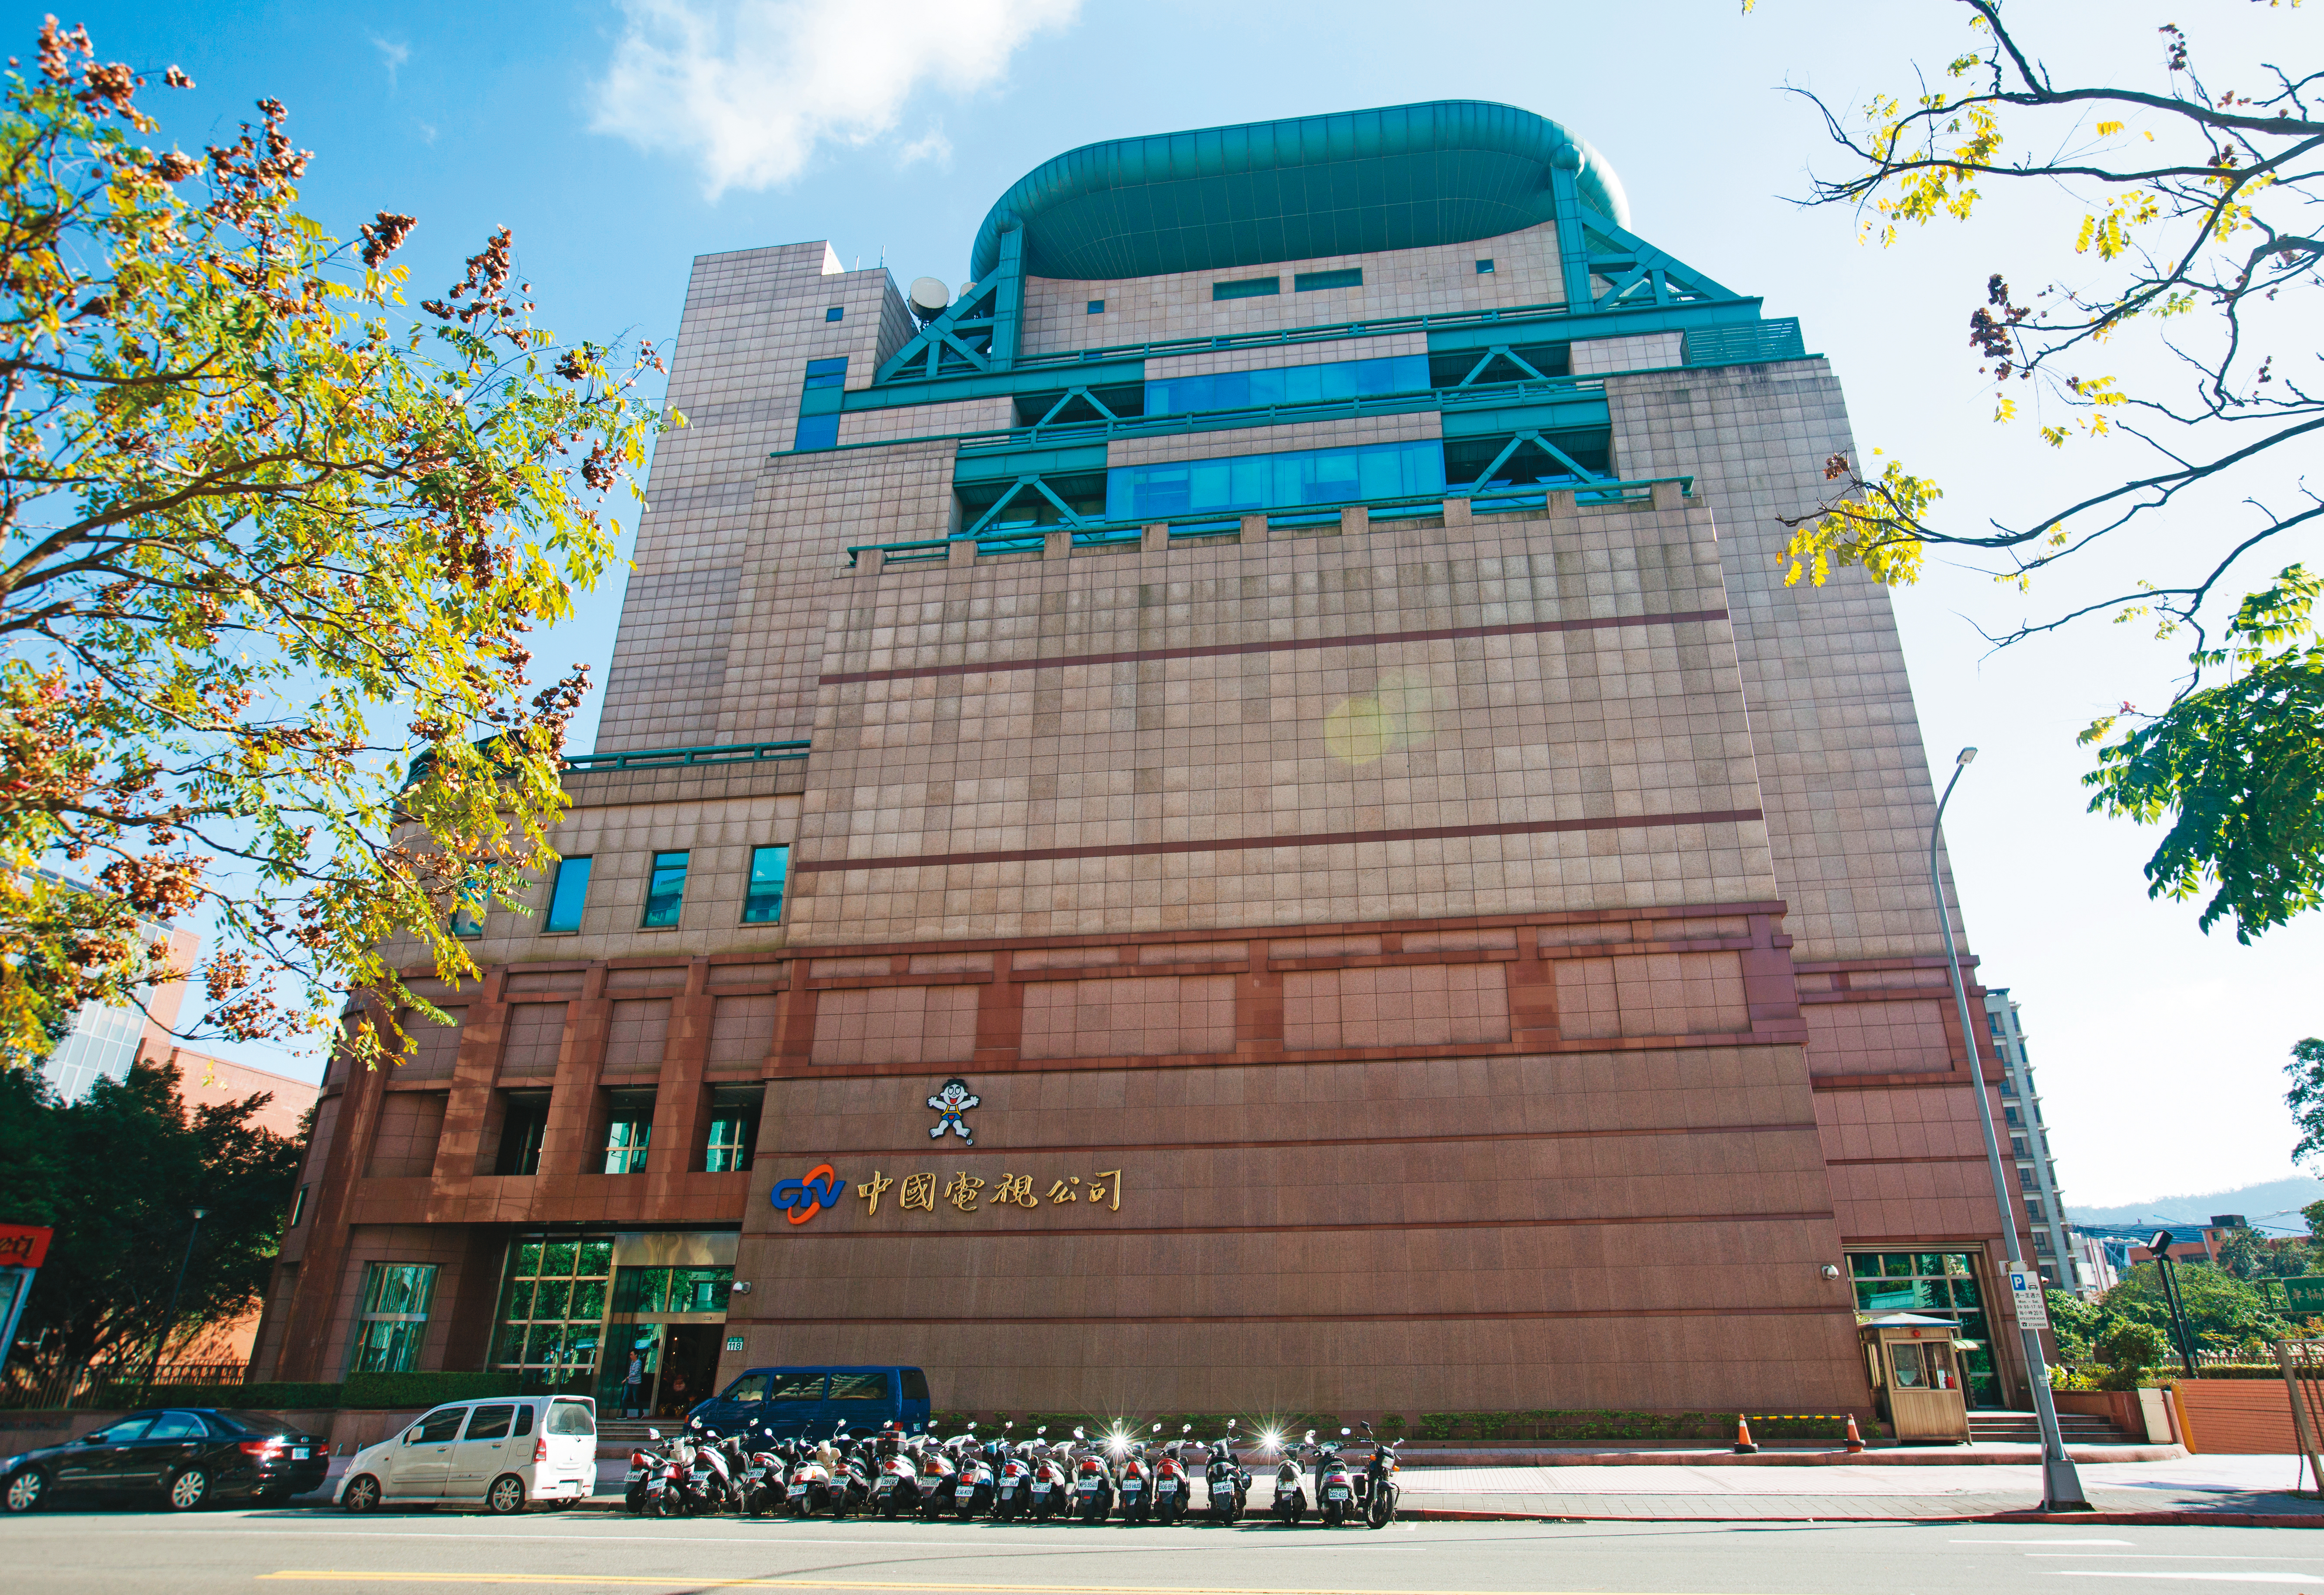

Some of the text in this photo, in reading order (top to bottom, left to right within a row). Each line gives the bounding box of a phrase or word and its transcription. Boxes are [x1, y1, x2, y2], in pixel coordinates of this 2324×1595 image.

[858, 1170, 1121, 1215] 中國電視公司
[2014, 1276, 2022, 1288] P
[2291, 1287, 2324, 1303] 車輛
[728, 1342, 741, 1350] 118
